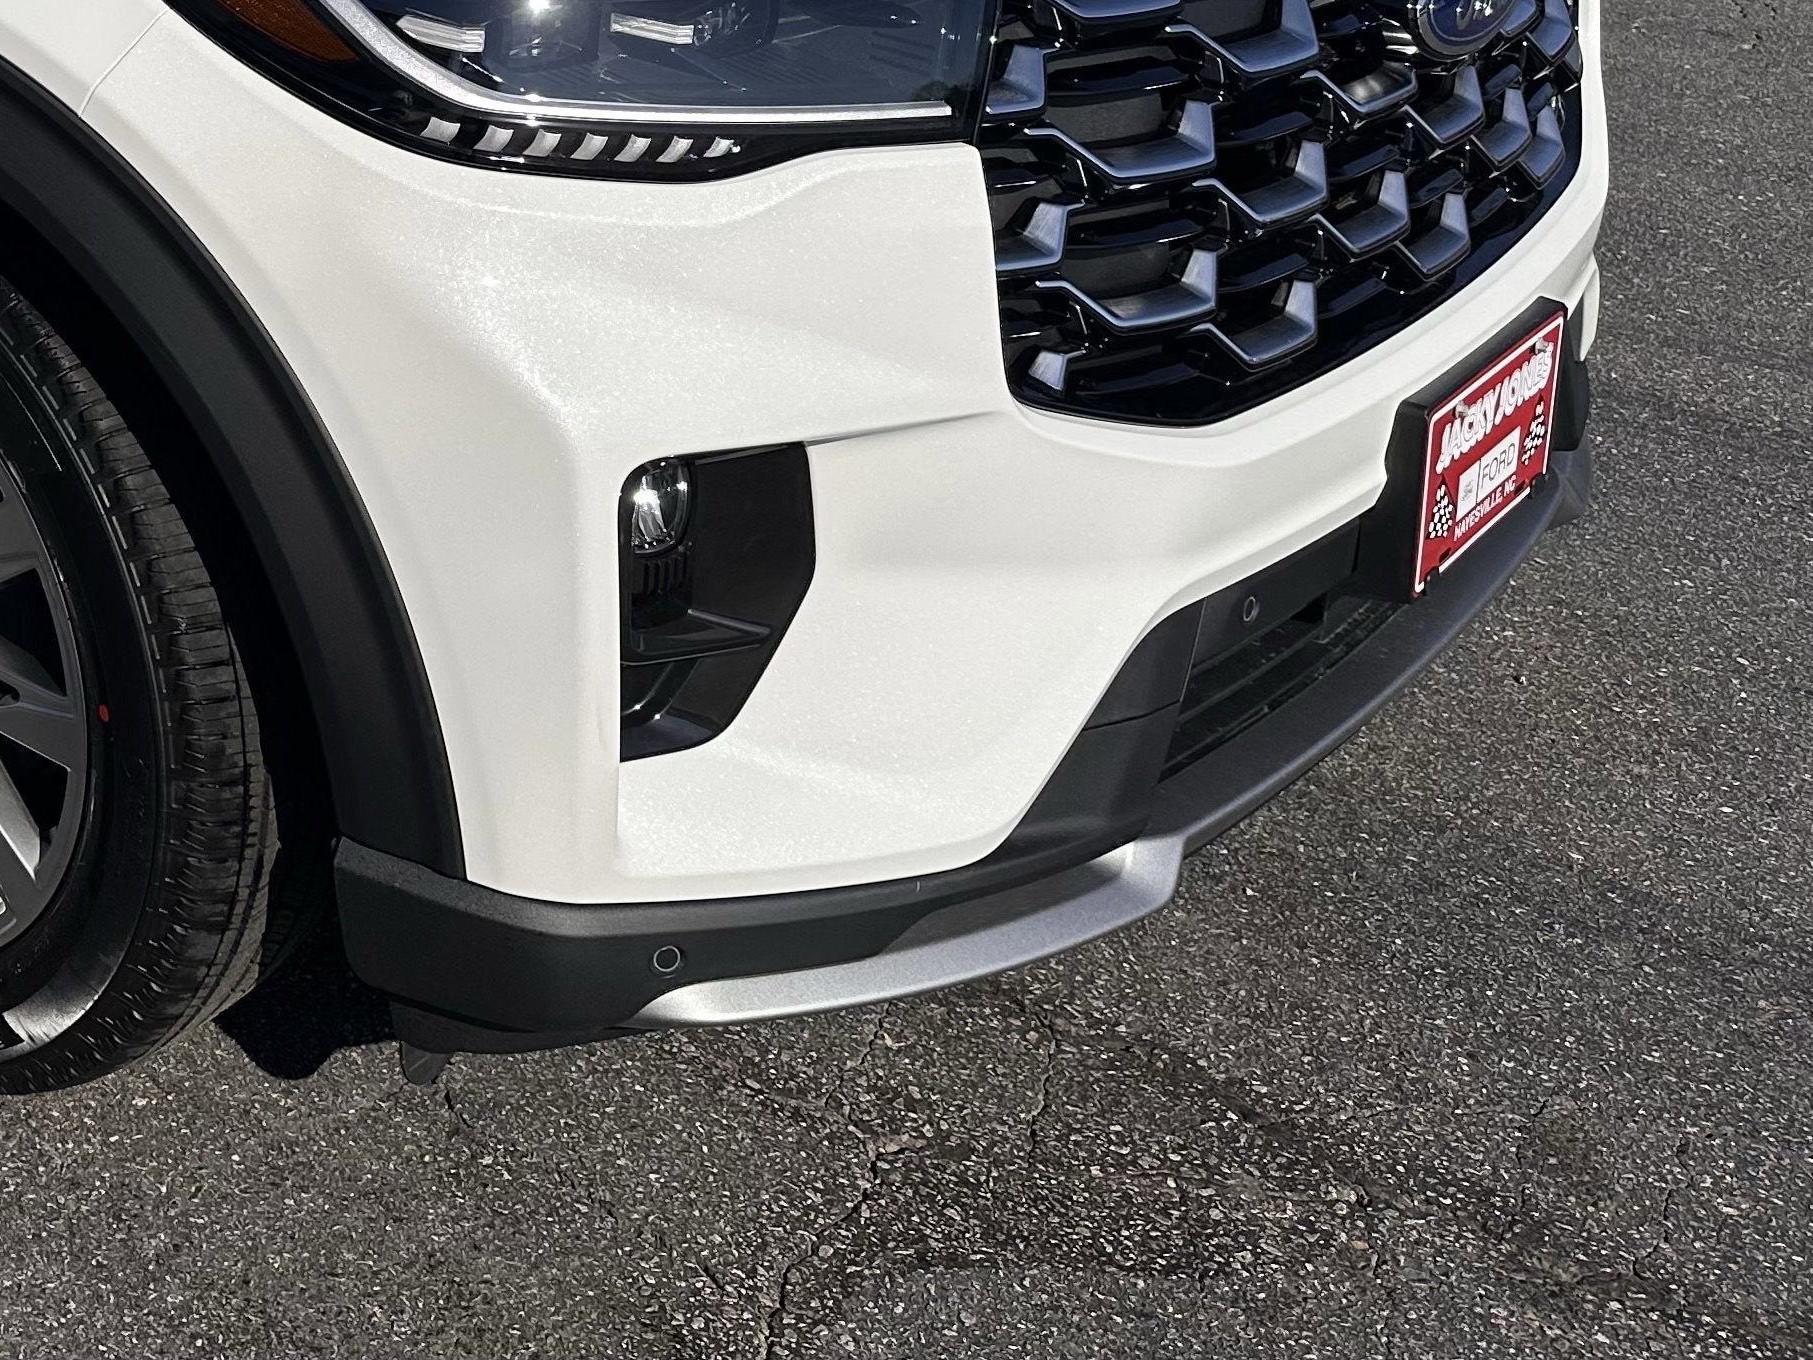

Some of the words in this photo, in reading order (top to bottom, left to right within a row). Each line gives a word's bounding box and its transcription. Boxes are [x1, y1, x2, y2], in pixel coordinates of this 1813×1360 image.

[1435, 382, 1501, 474] JACKY
[1494, 341, 1555, 425] JONES
[1480, 442, 1516, 489] FORD
